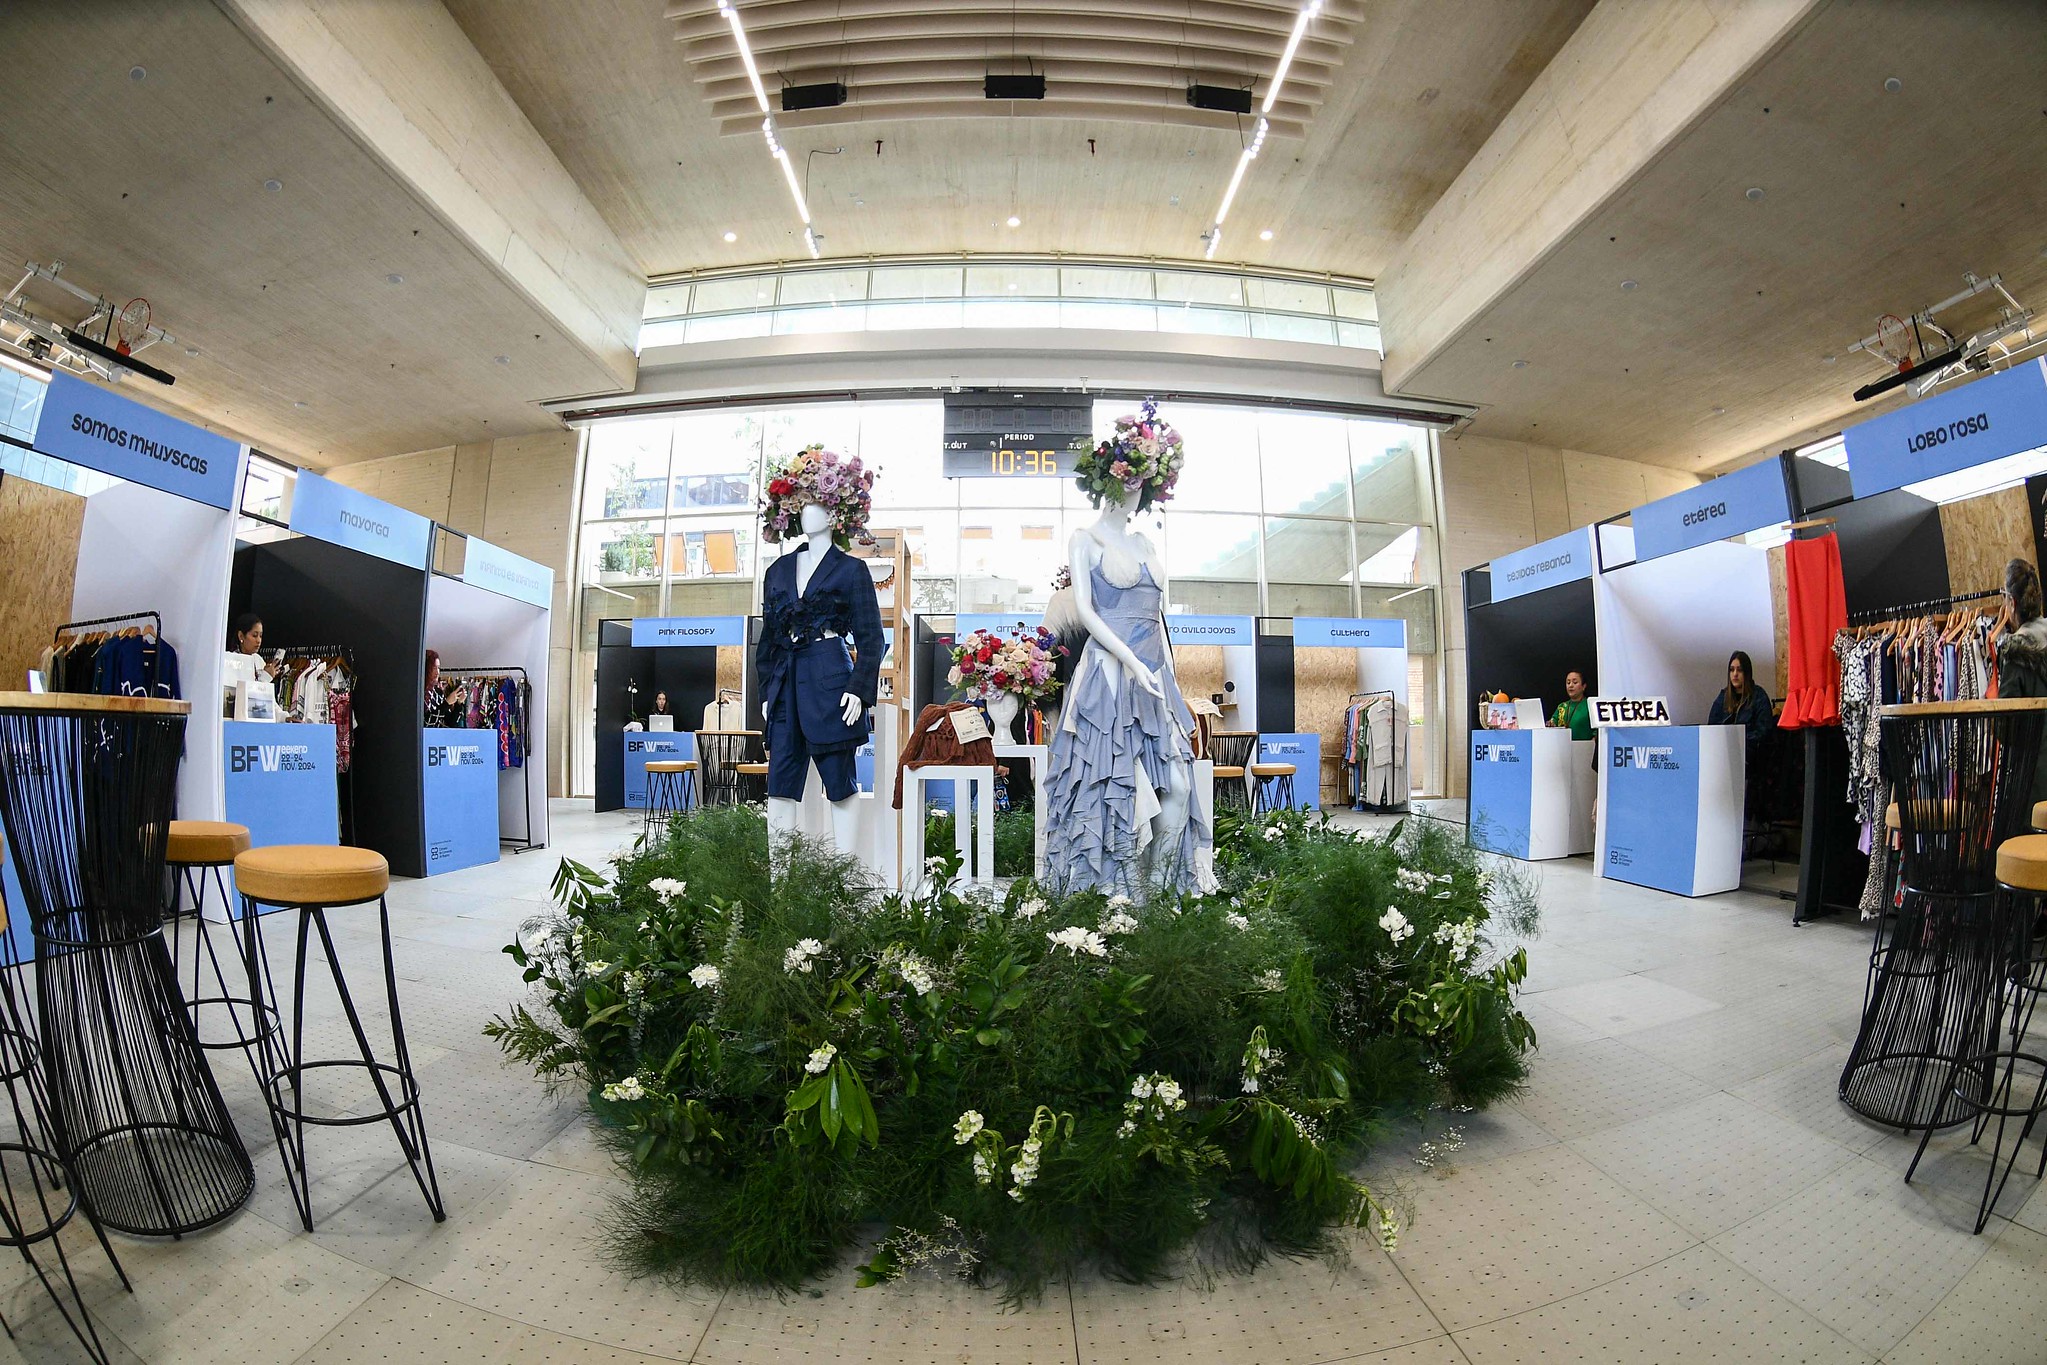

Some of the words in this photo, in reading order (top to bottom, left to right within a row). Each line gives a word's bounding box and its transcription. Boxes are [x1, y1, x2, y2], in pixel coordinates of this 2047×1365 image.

[71, 413, 128, 447] somos
[1004, 433, 1035, 441] PERIOD
[1907, 427, 1947, 454] LOBO
[1948, 412, 1989, 440] rosa
[991, 450, 1057, 475] 10:36
[1682, 502, 1726, 527] etérea
[1595, 697, 1670, 722] ETÉREA
[298, 762, 316, 771] 2024
[1663, 762, 1680, 770] 2024
